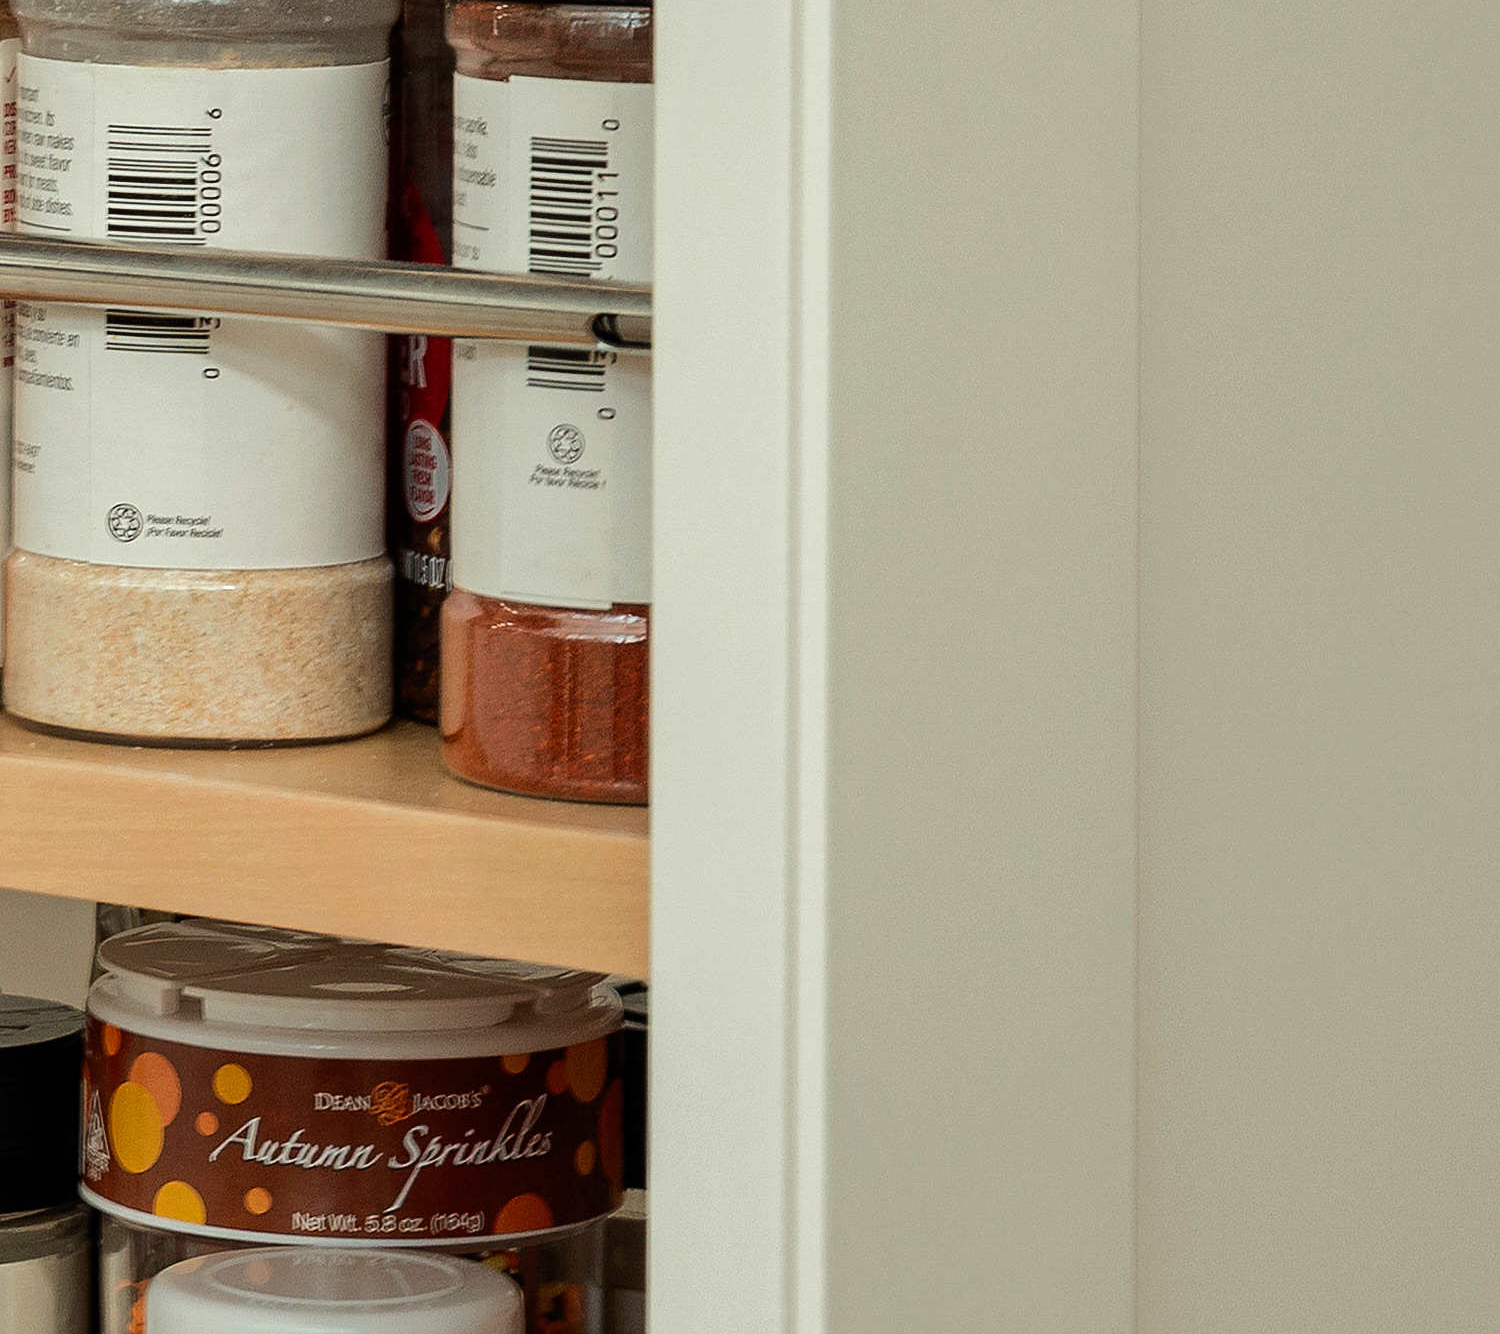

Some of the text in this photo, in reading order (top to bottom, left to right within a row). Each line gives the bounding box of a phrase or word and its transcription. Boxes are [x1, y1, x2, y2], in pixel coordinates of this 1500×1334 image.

[313, 1091, 373, 1112] DEAN
[208, 1092, 555, 1211] Autumn Sprinkles
[292, 1211, 485, 1236] Net Wt. 5.8 oz. (164g)
